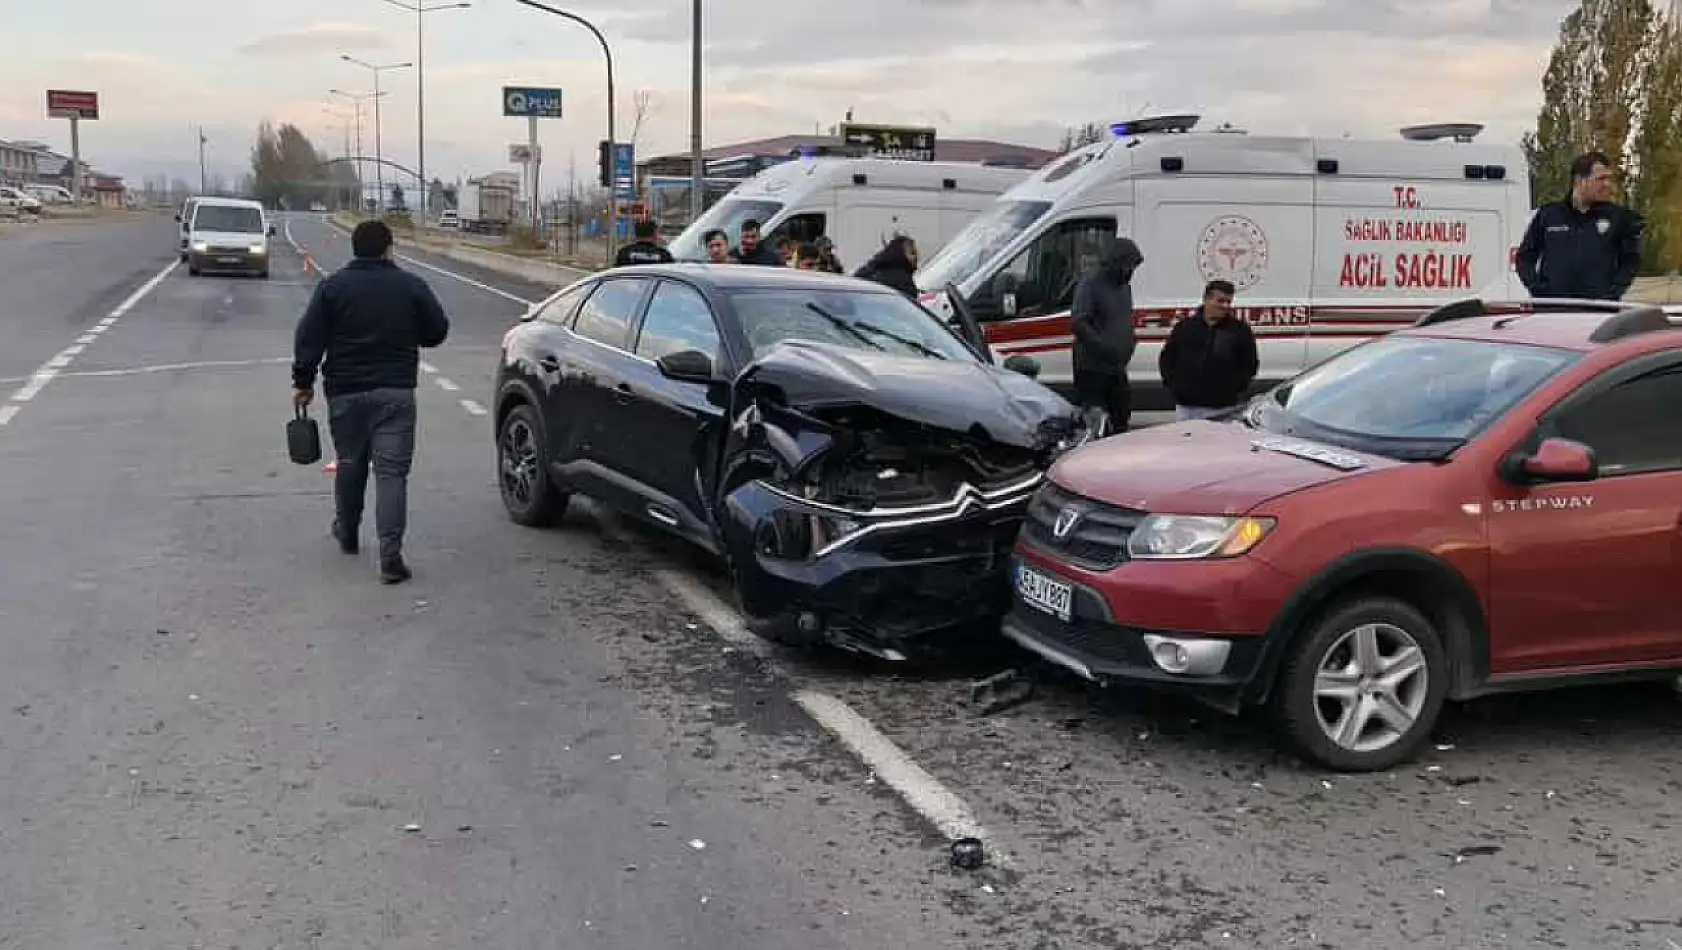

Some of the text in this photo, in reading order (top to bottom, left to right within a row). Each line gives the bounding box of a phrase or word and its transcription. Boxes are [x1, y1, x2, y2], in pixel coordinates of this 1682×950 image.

[1393, 187, 1421, 209] T.C.
[1394, 249, 1472, 288] SAĞLIK
[1491, 496, 1596, 513] STEPWAY
